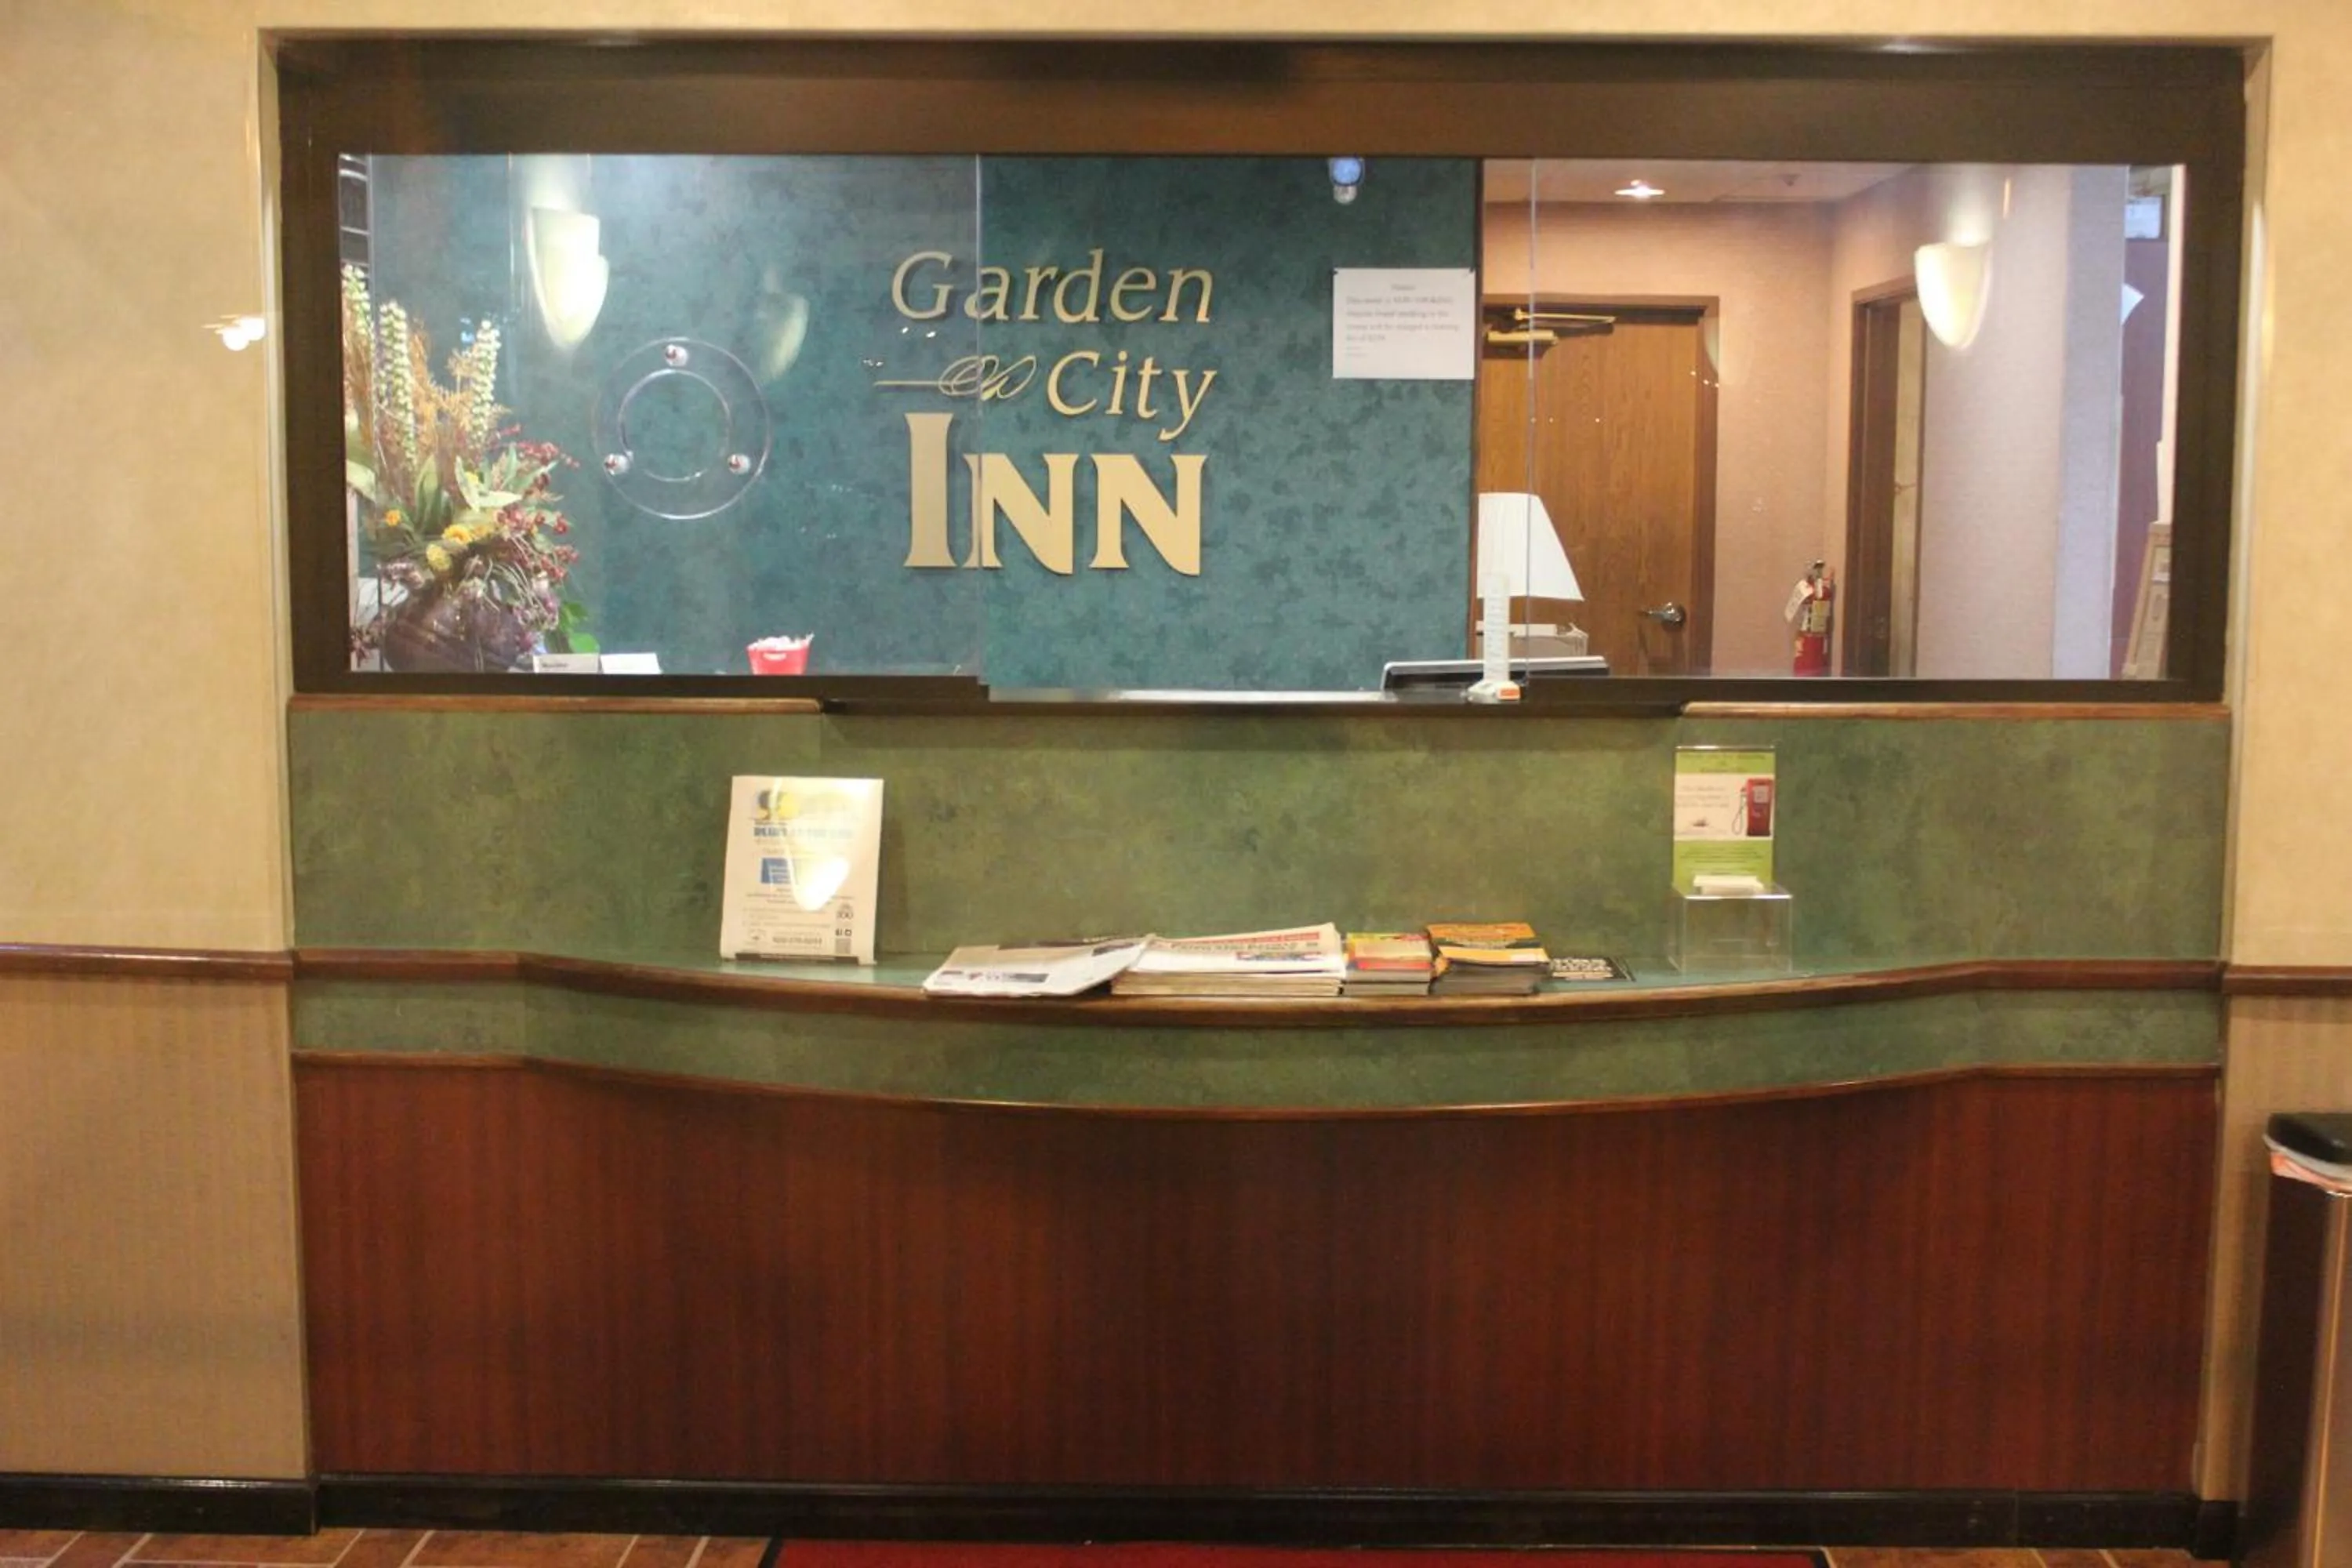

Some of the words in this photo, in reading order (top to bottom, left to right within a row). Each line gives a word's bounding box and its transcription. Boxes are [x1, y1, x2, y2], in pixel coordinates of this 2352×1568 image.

[891, 249, 1214, 323] Garden
[1047, 350, 1217, 441] City
[903, 412, 1208, 575] INN
